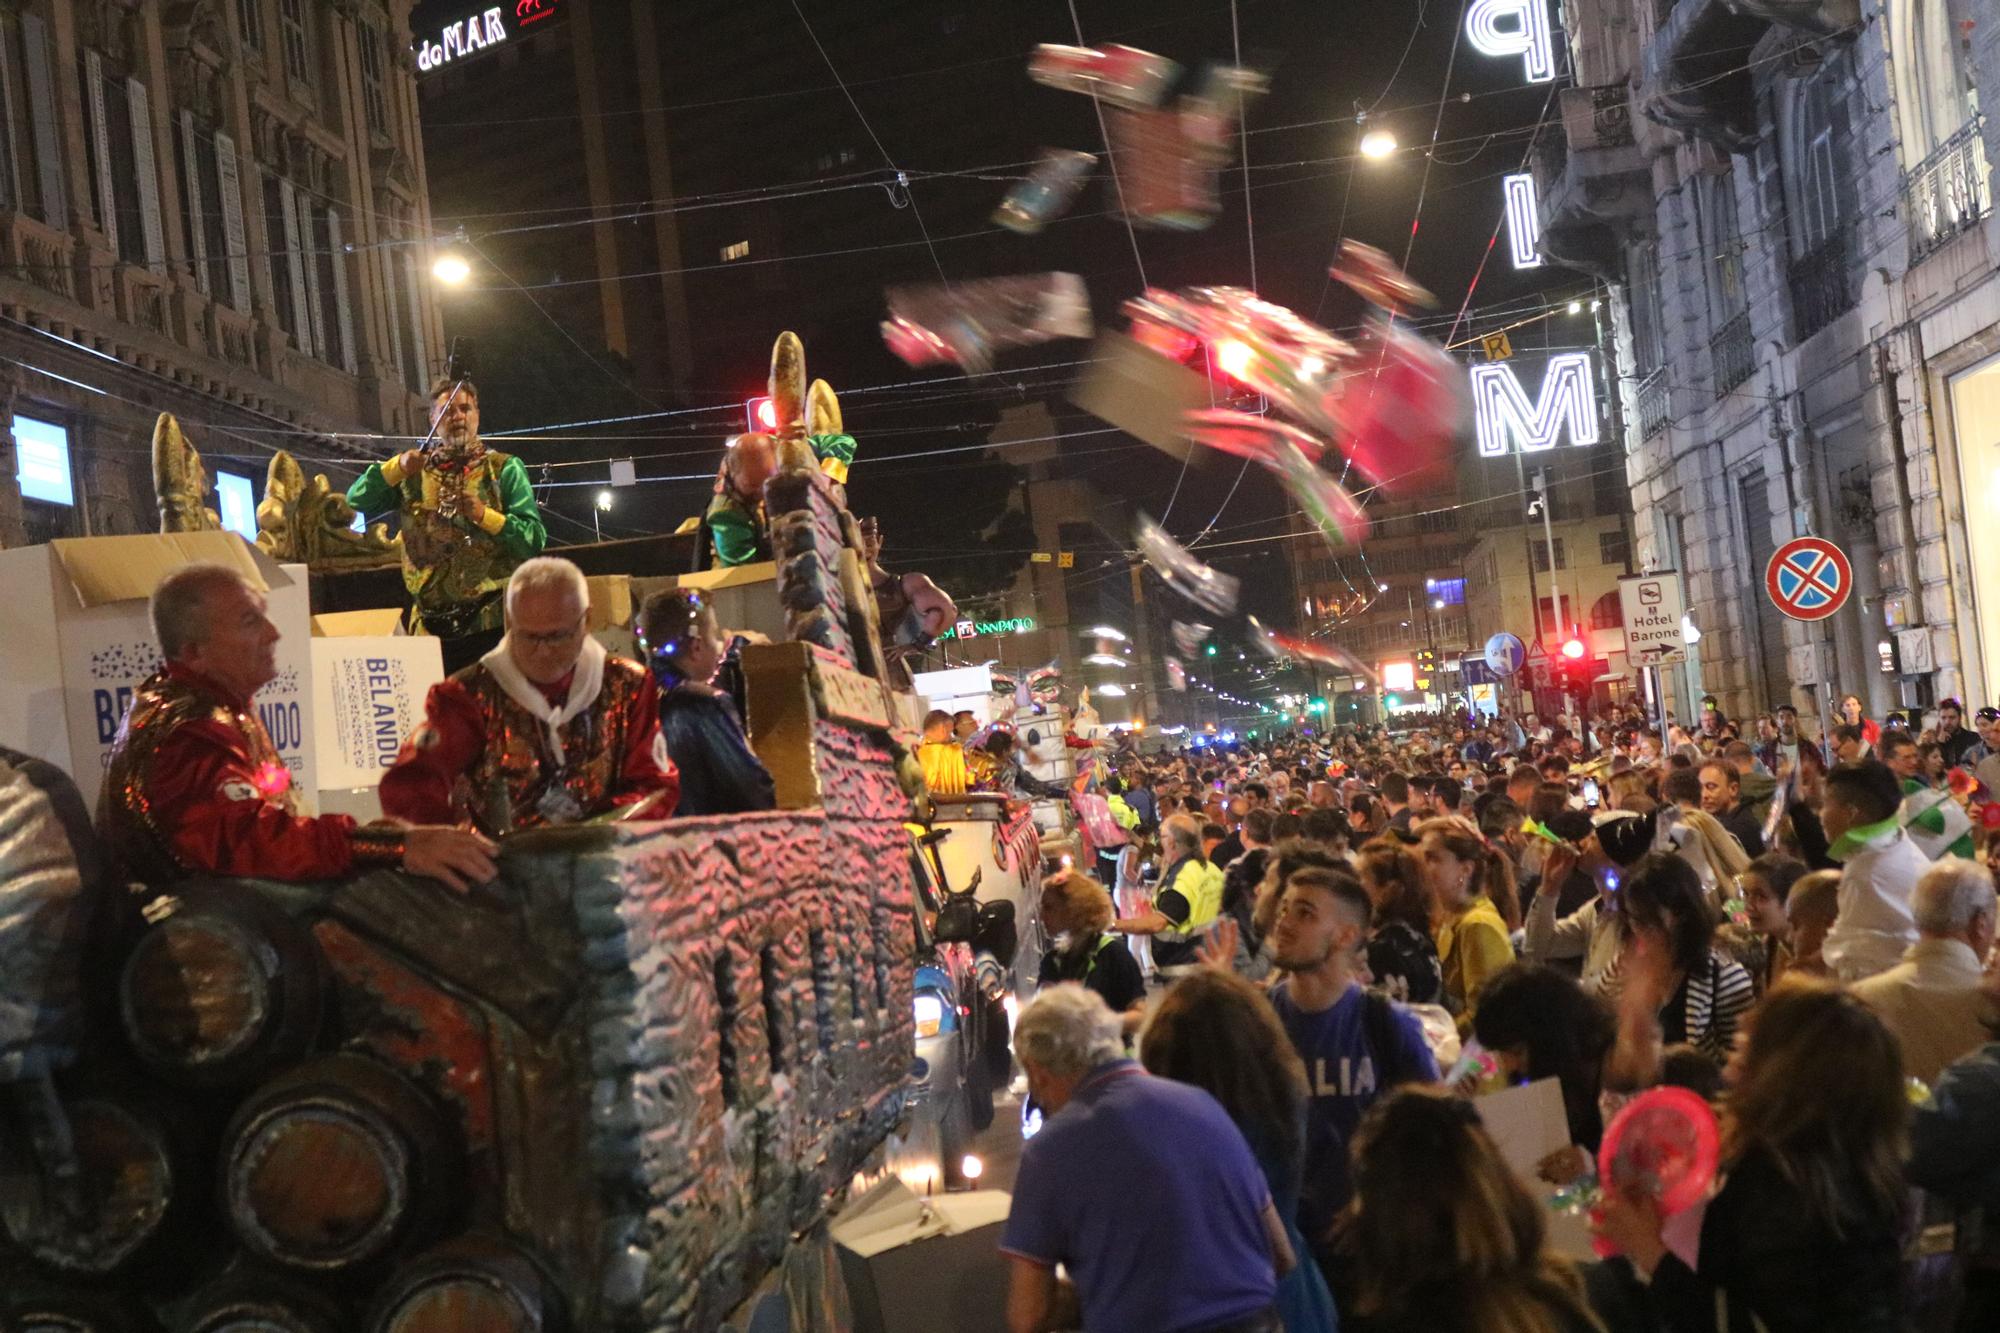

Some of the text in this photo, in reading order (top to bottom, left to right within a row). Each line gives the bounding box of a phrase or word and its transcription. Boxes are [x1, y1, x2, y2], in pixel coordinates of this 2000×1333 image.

[409, 7, 507, 71] doMAR
[975, 617, 1034, 635] SANPAOLO
[1634, 613, 1673, 628] Hotel
[1630, 629, 1680, 642] Barone
[366, 658, 401, 768] BELANDO
